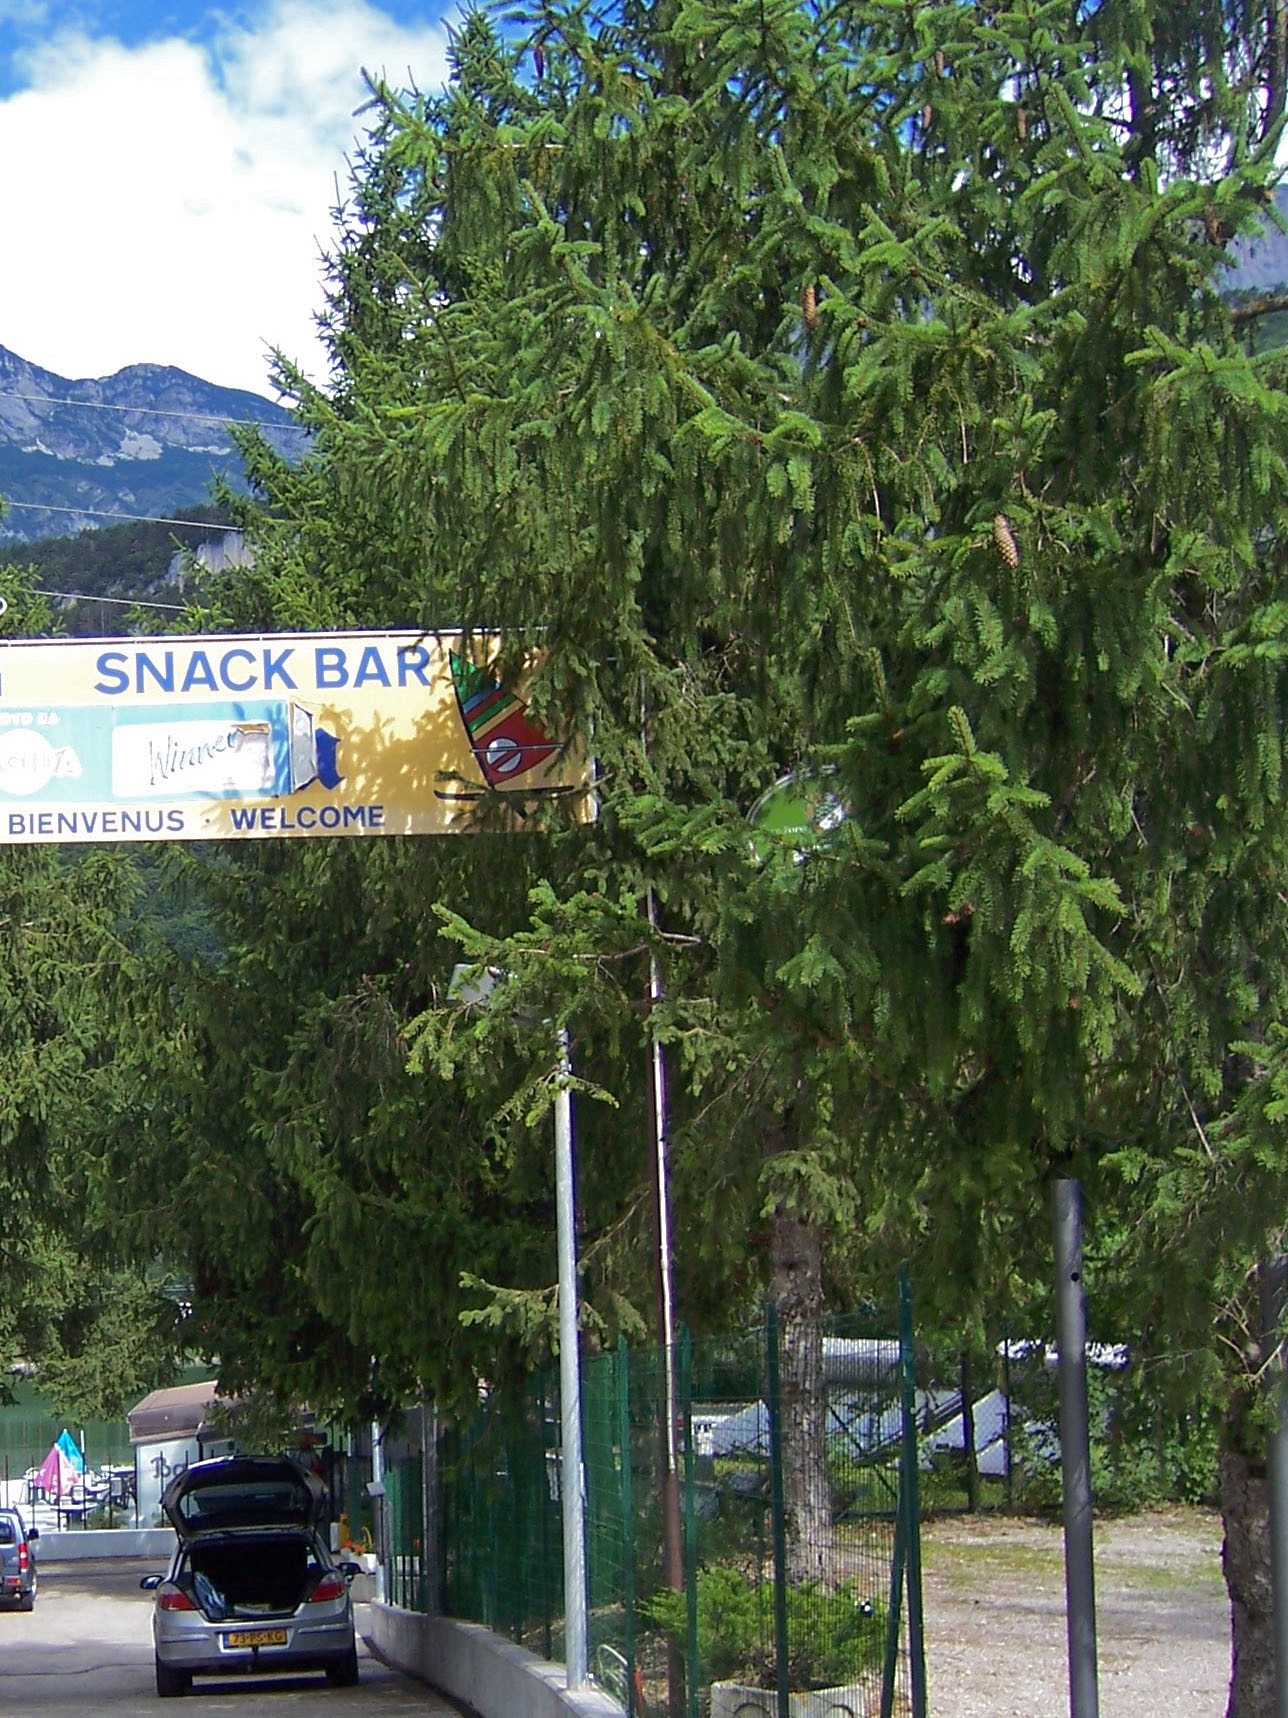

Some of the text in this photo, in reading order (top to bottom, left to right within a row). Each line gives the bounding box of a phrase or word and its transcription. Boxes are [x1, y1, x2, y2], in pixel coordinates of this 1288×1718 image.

[94, 648, 298, 695] SNACK
[315, 645, 432, 689] BAR
[149, 729, 239, 786] Winner
[8, 810, 185, 835] BIENVENUS
[230, 805, 385, 830] WELCOME
